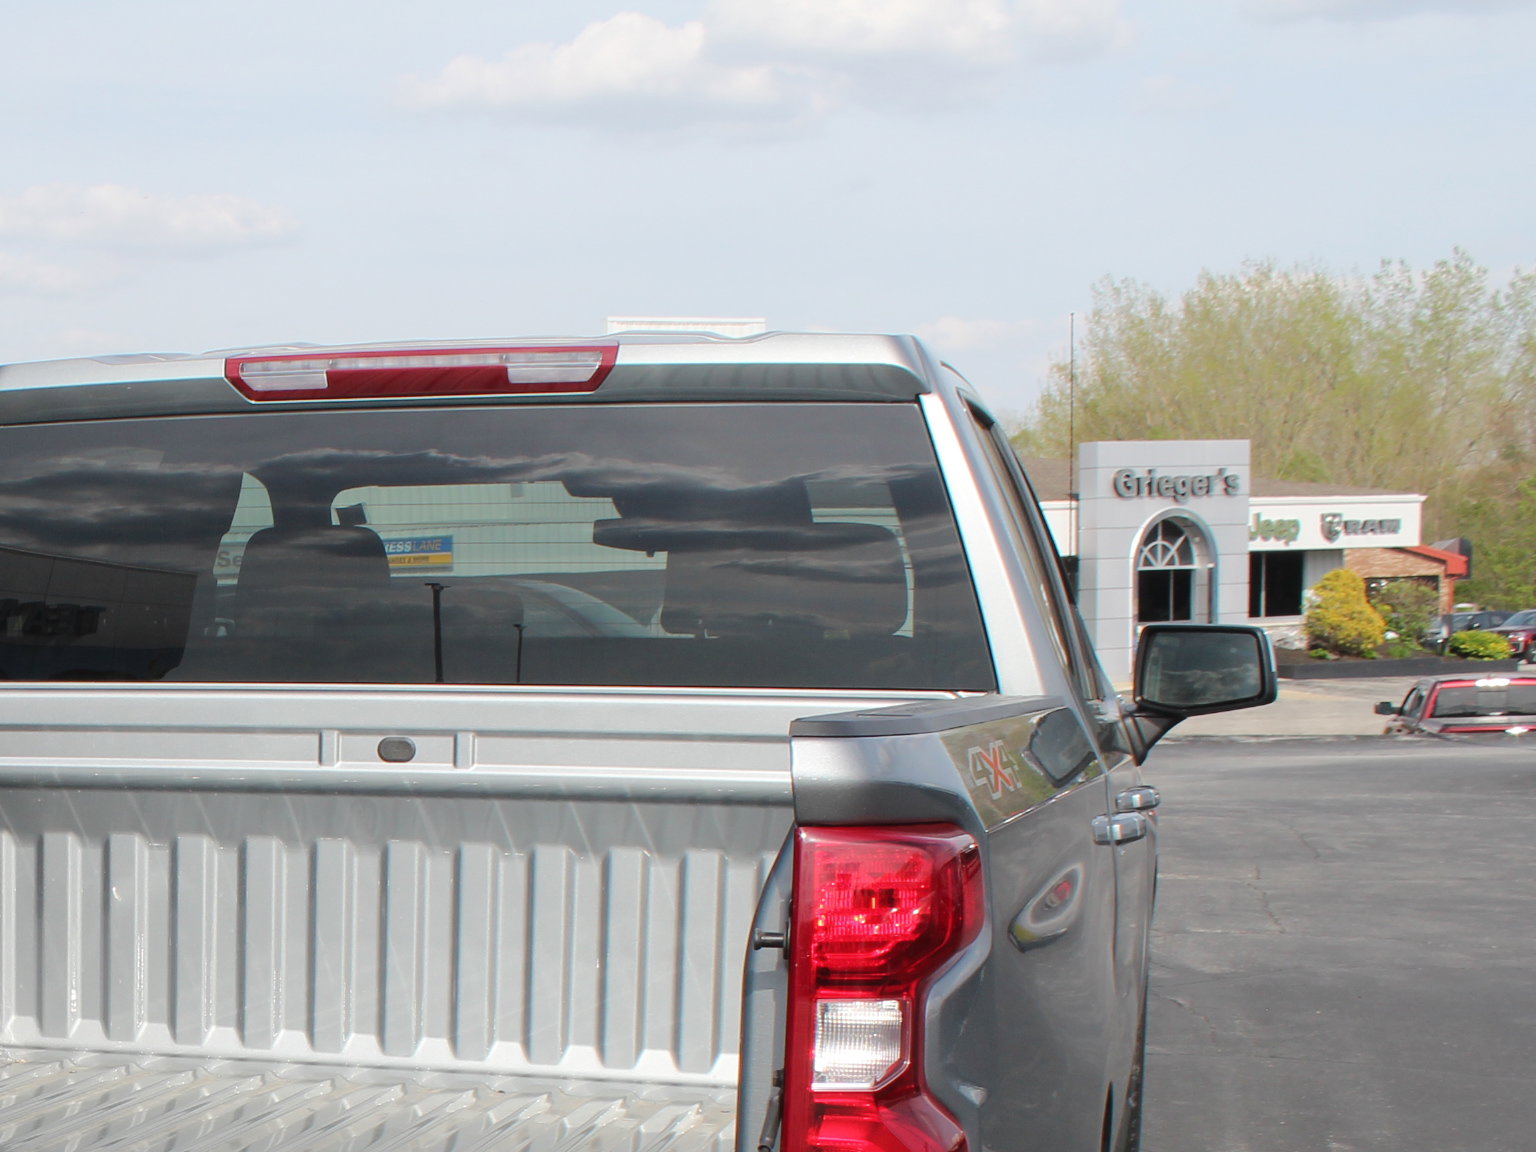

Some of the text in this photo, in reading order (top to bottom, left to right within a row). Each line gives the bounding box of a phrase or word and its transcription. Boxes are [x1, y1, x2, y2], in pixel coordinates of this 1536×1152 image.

[1113, 467, 1240, 504] Grieger's
[1249, 512, 1300, 546] Jeep
[1343, 519, 1402, 535] RAM
[413, 538, 442, 552] LANE
